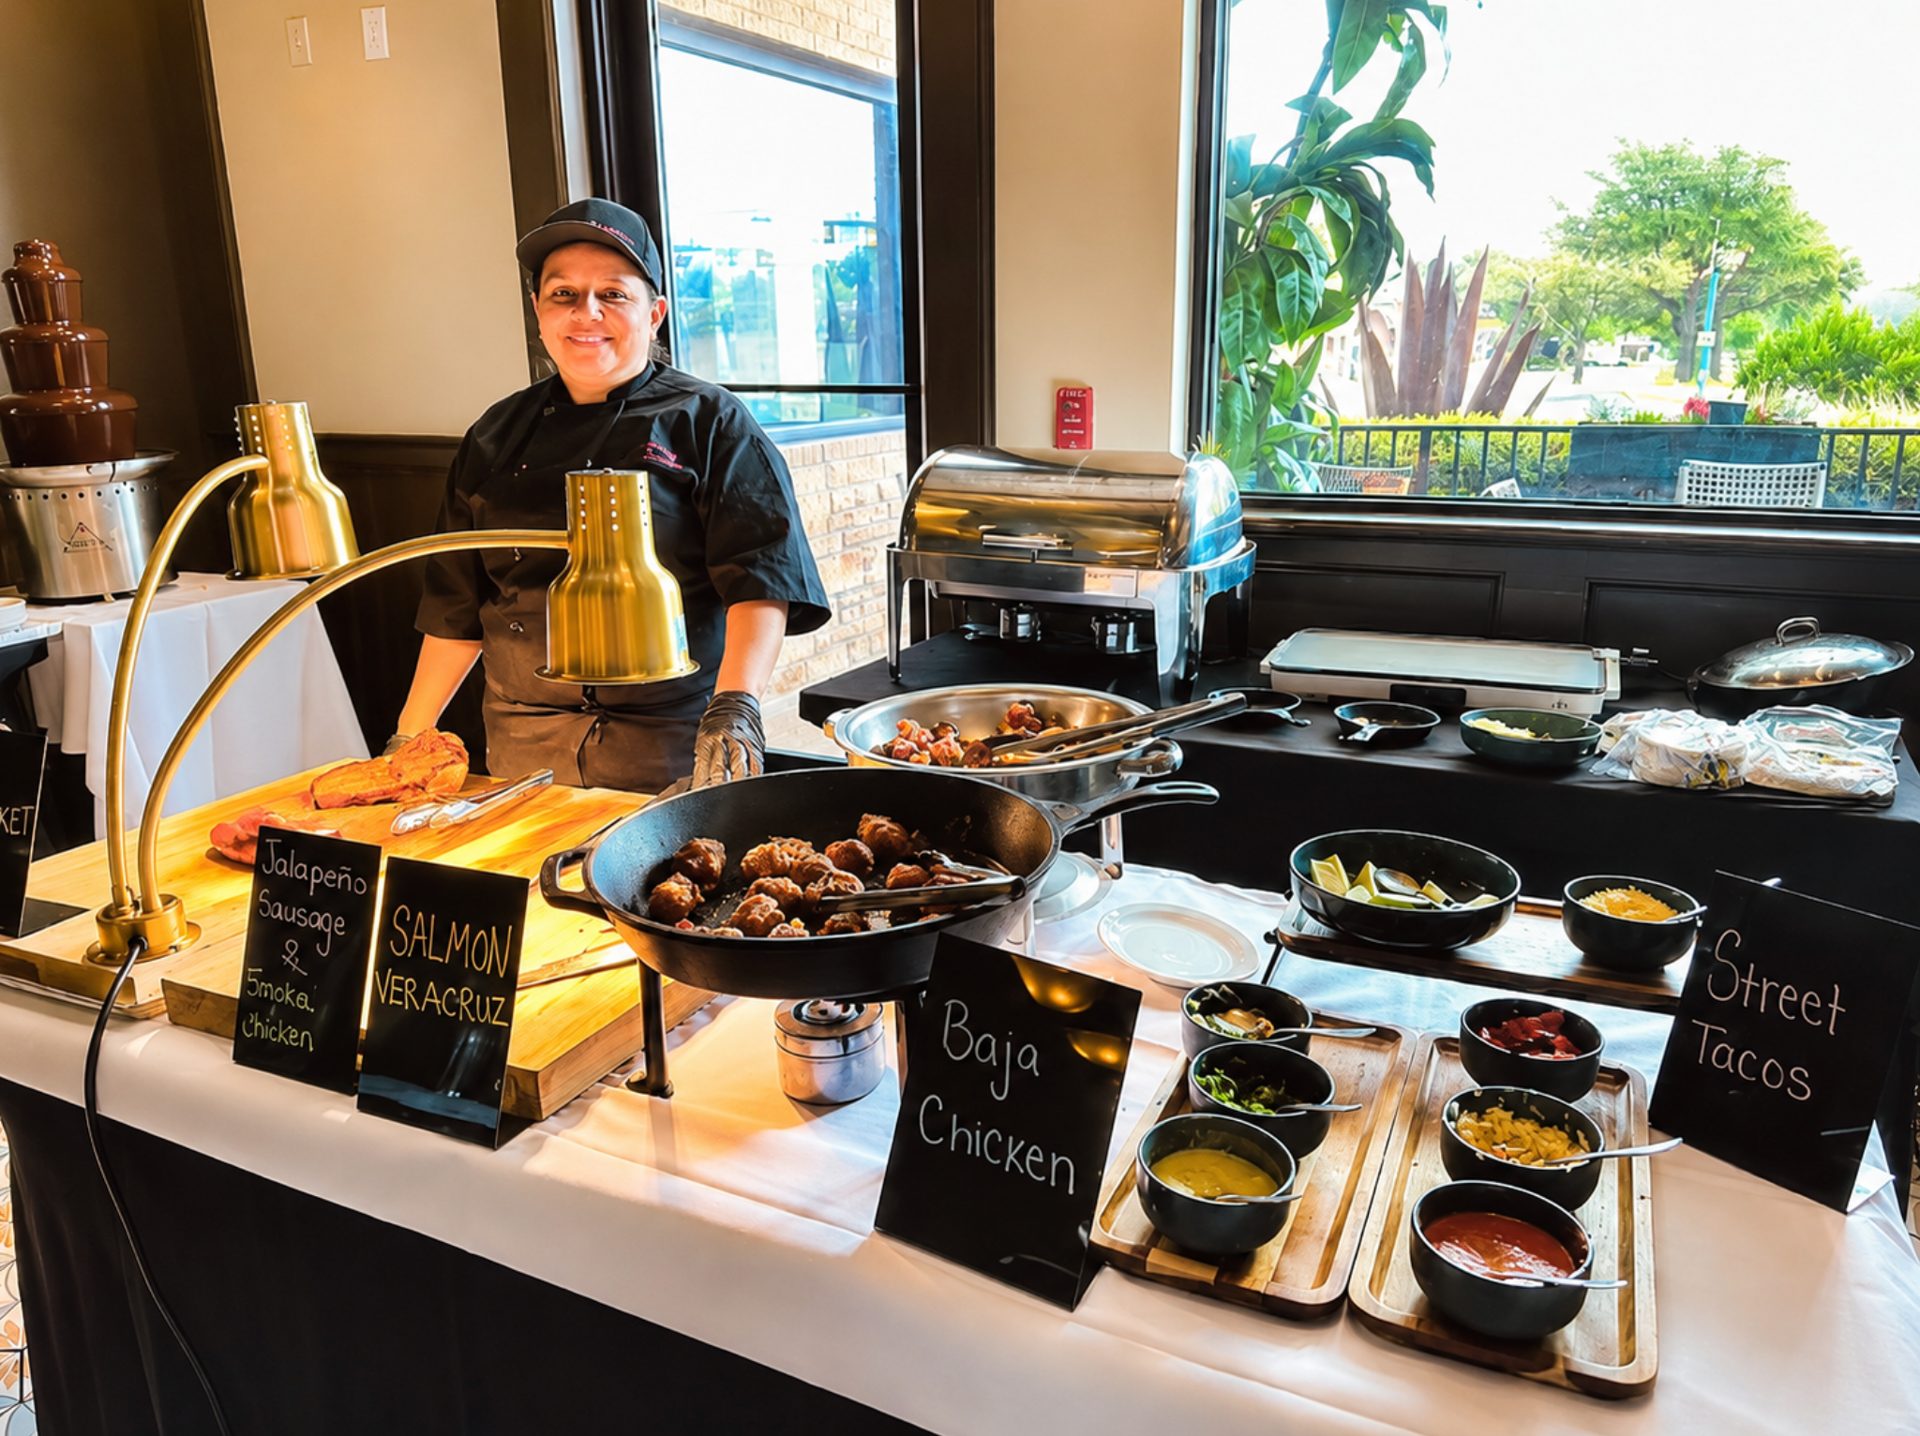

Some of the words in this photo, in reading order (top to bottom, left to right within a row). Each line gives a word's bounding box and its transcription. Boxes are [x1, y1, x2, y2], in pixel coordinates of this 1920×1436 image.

[262, 839, 367, 896] Jalapeño
[258, 889, 345, 956] Sausage
[281, 939, 308, 976] &
[390, 904, 513, 978] SALMON
[375, 968, 509, 1027] VERACRUZ
[1707, 929, 1846, 1036] Street
[242, 1011, 314, 1052] Chicken
[943, 999, 1040, 1101] Baja
[1692, 1019, 1812, 1101] Tacos
[919, 1094, 1075, 1195] Chicken
